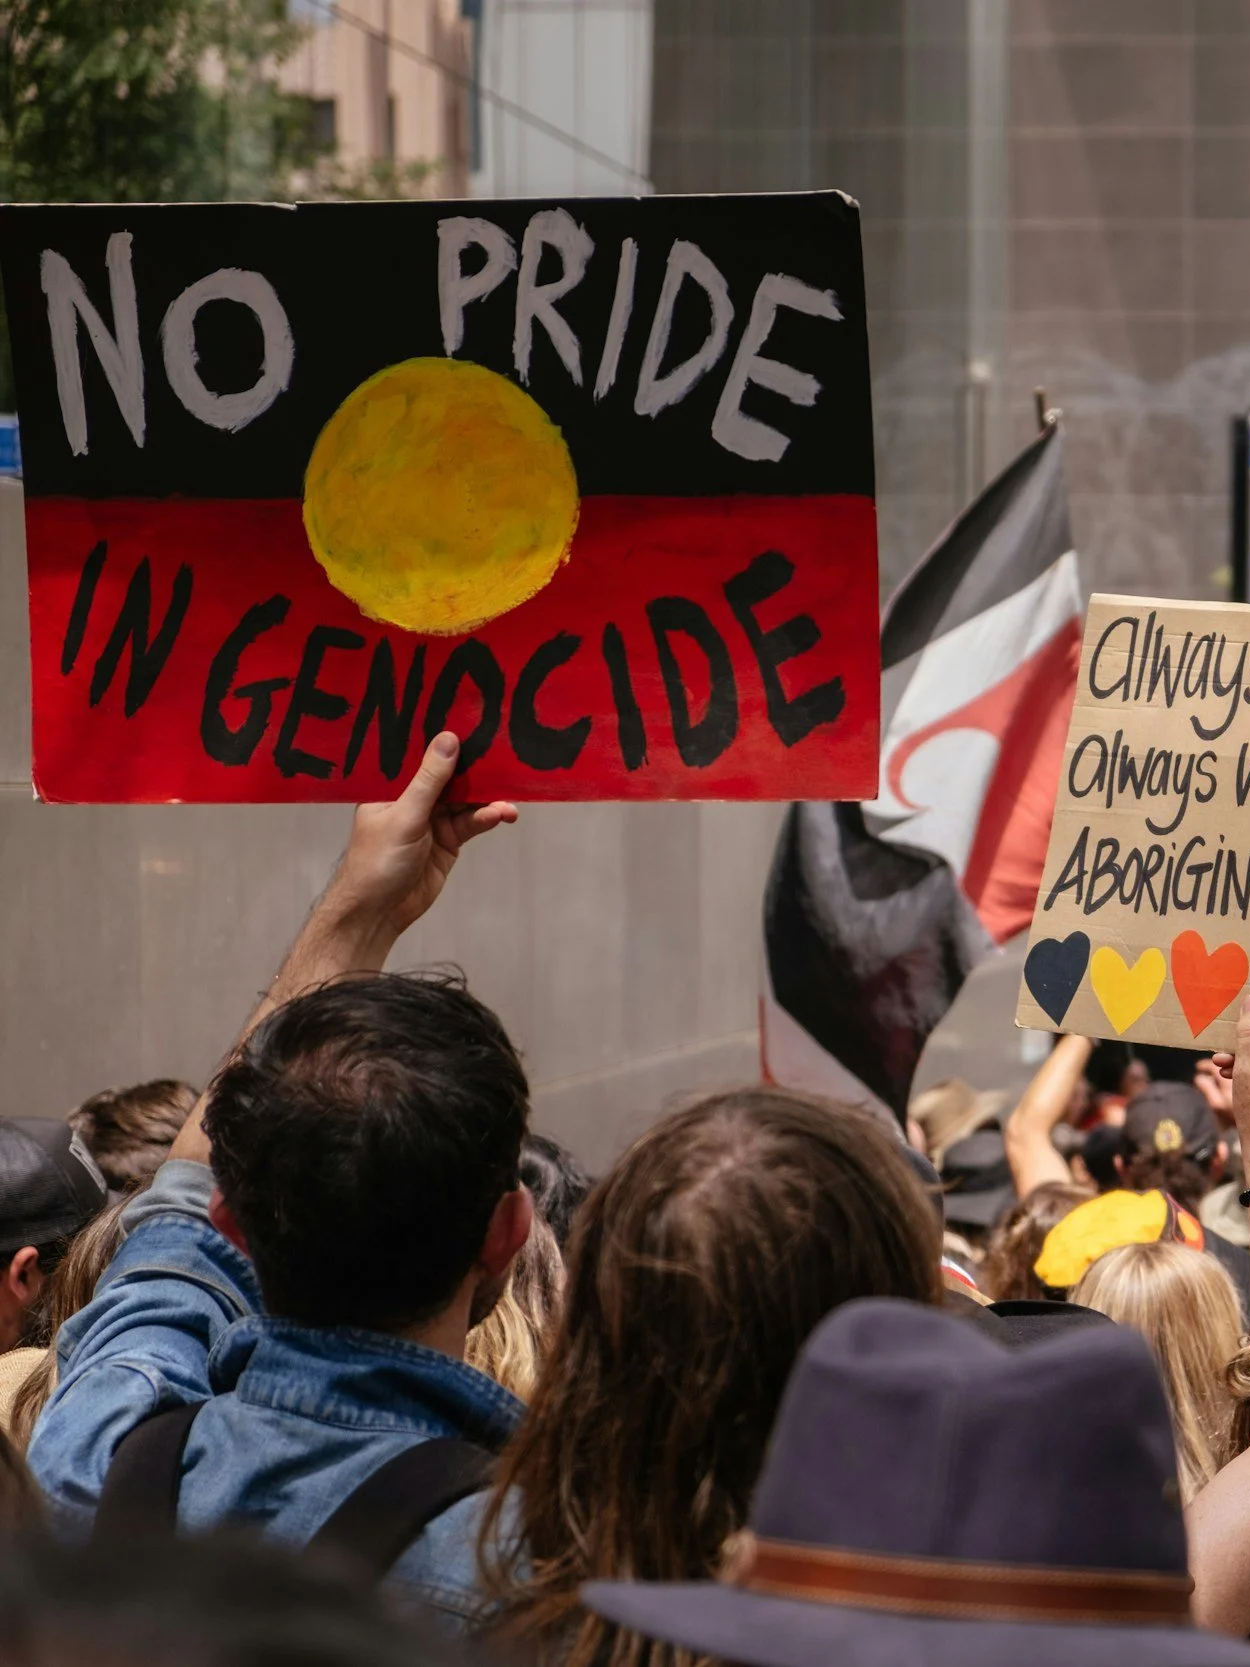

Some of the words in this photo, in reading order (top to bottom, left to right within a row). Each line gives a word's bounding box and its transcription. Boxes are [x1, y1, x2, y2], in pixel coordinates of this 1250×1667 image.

[41, 231, 294, 457] NO
[436, 206, 844, 463] PRIDE
[61, 540, 194, 718] IN
[200, 550, 845, 783] GENOCIDE
